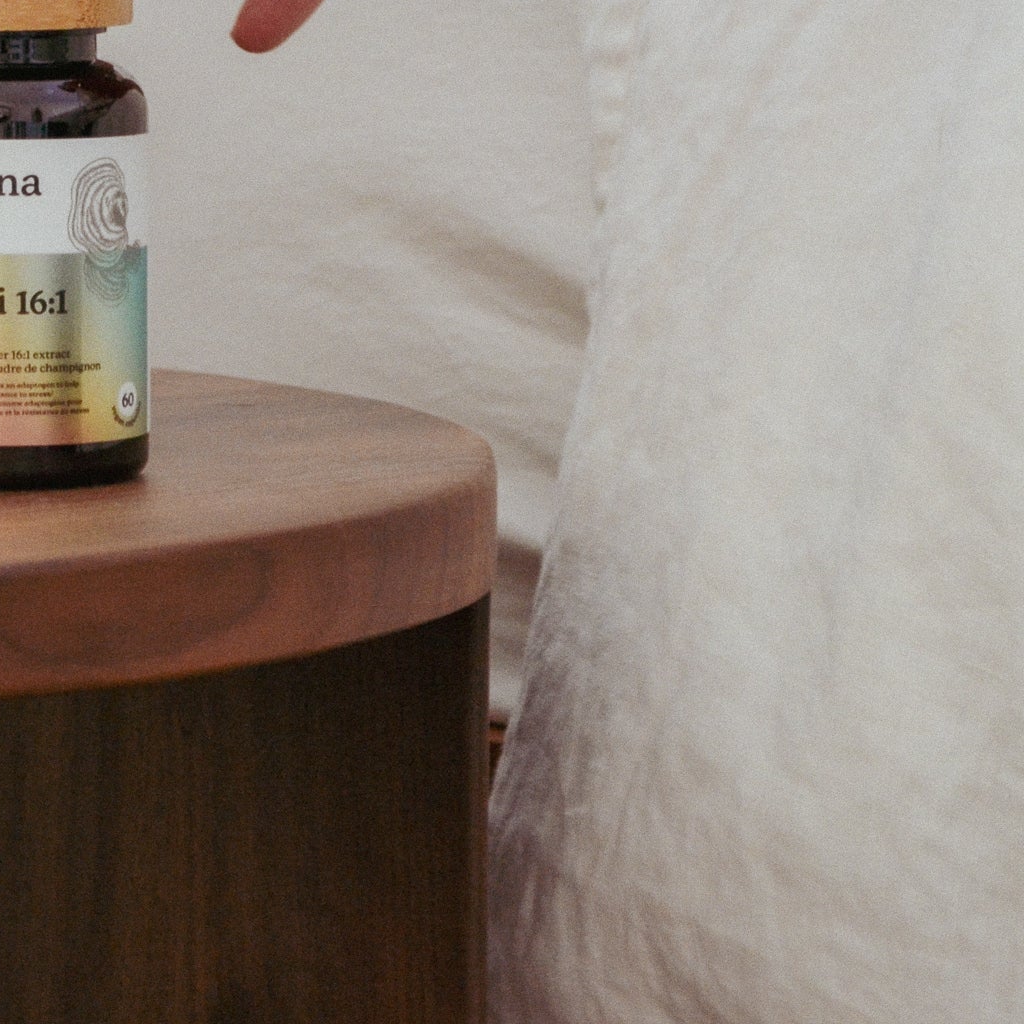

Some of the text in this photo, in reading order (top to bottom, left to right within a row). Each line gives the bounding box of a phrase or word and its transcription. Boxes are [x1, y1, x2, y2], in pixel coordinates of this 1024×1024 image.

[16, 290, 68, 315] 16:1
[11, 351, 30, 360] 16:1
[32, 351, 71, 360] extract
[24, 364, 38, 373] de
[39, 363, 101, 375] champignon
[121, 392, 134, 408] 60
